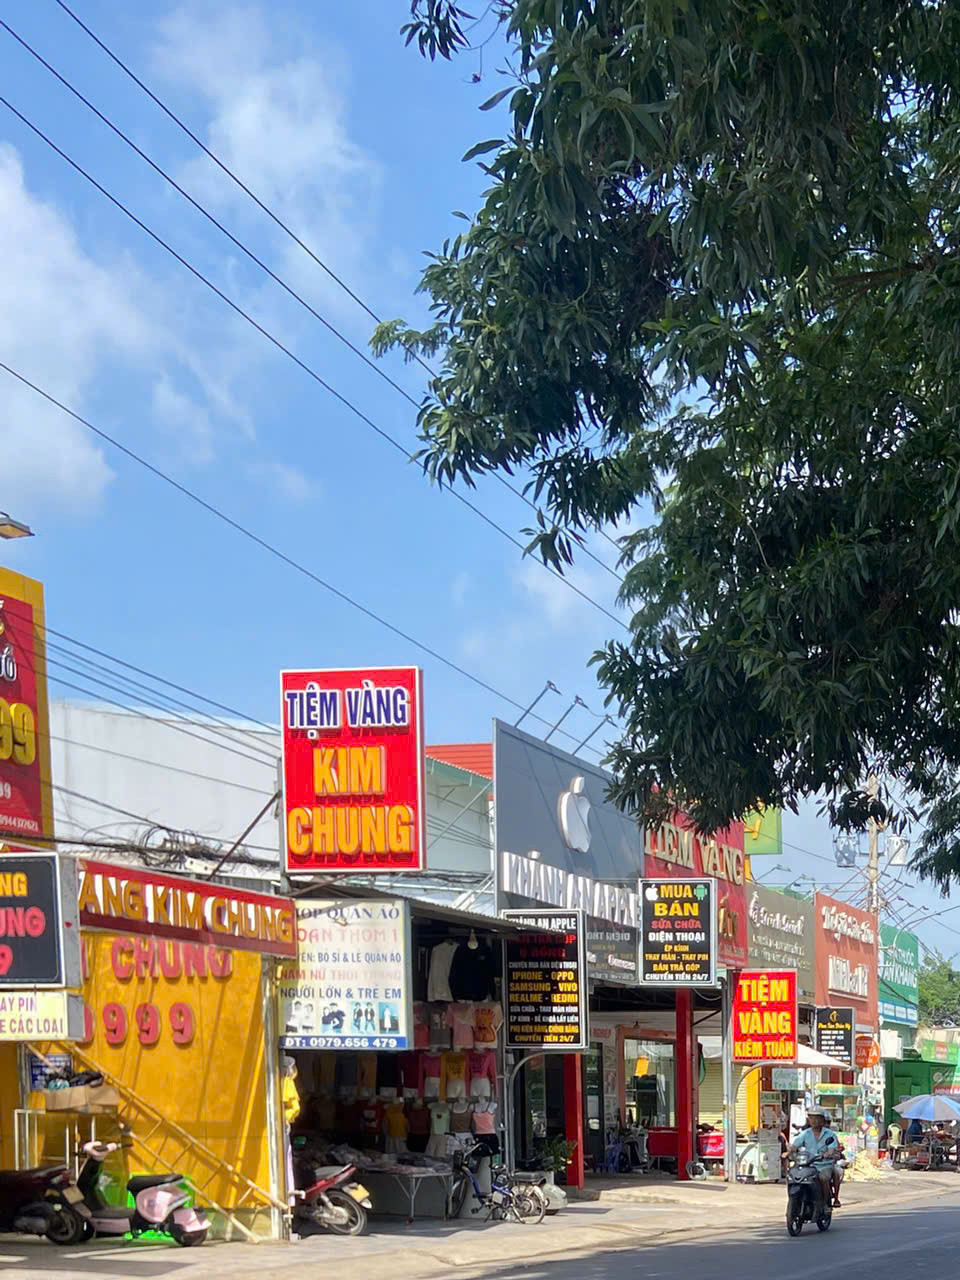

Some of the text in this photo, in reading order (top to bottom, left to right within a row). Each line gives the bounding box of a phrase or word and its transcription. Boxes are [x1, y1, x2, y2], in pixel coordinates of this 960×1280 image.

[285, 680, 409, 740] TIỆM VÀNG
[313, 745, 385, 796] KIM
[288, 804, 414, 857] CHUNG
[502, 850, 566, 907] KHÁNH
[660, 885, 692, 898] MUA
[146, 884, 201, 930] KIM
[204, 896, 293, 943] CHUNG
[654, 900, 699, 916] BÁN
[551, 918, 577, 929] APPLE
[676, 931, 705, 943] THOẠI
[111, 935, 232, 979] CHUNG
[512, 972, 543, 981] IPHONE
[551, 971, 574, 981] OPPO
[346, 988, 353, 998] &
[385, 989, 402, 998] EM
[509, 982, 551, 992] SAMSUNG
[558, 982, 578, 992] VIVO
[740, 974, 788, 1007] TIỆM
[509, 993, 543, 1003] REALME
[551, 993, 578, 1003] REDMI
[739, 1008, 791, 1034] VÀNG
[373, 1037, 397, 1049] 479
